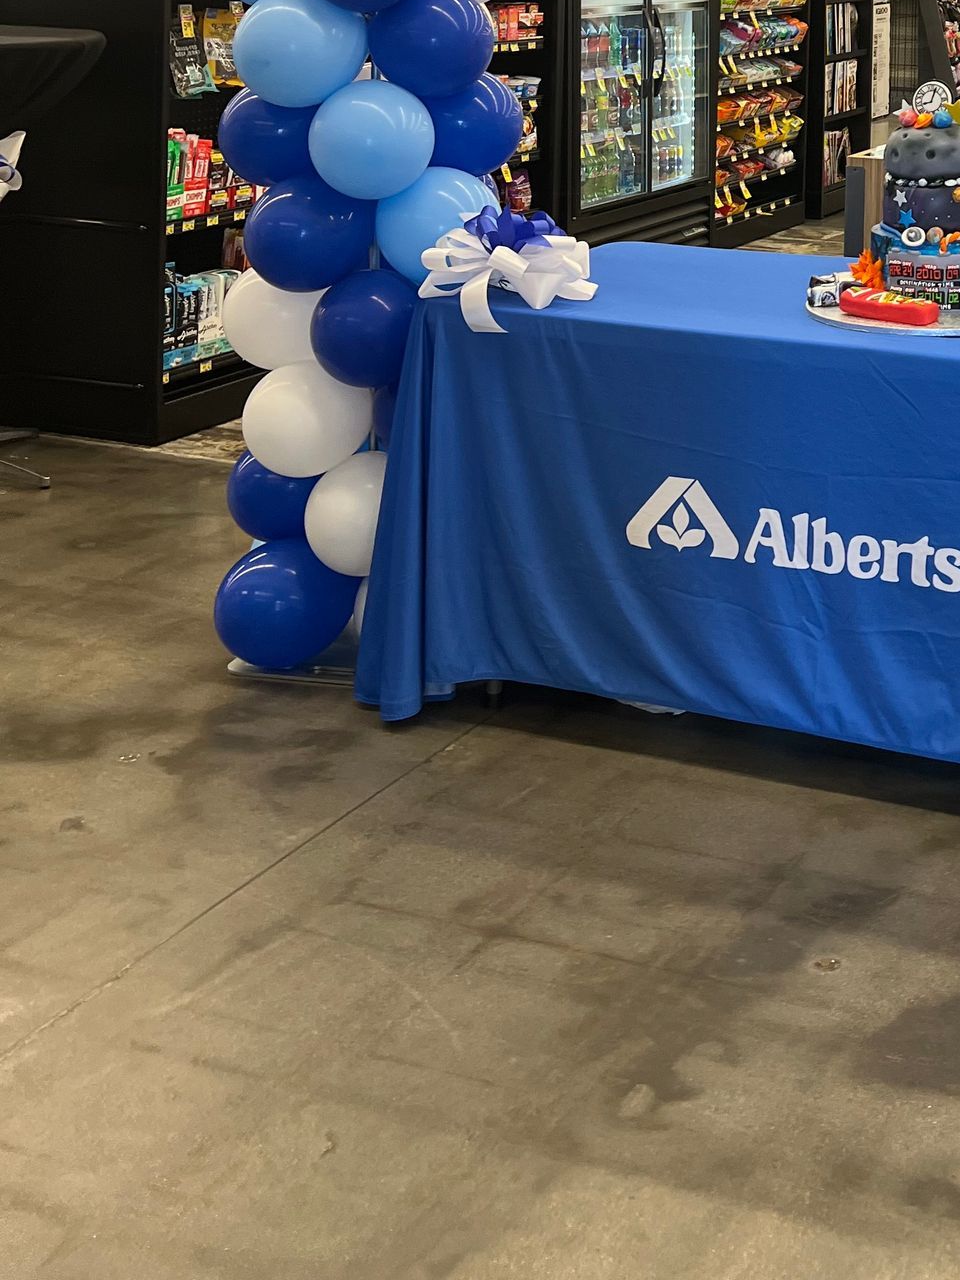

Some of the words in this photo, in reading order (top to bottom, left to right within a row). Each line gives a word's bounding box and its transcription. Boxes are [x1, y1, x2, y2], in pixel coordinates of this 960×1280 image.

[185, 191, 204, 202] CHOMPS
[902, 267, 912, 276] 24
[916, 268, 941, 280] 2010
[947, 269, 959, 280] 09
[948, 293, 960, 303] 02
